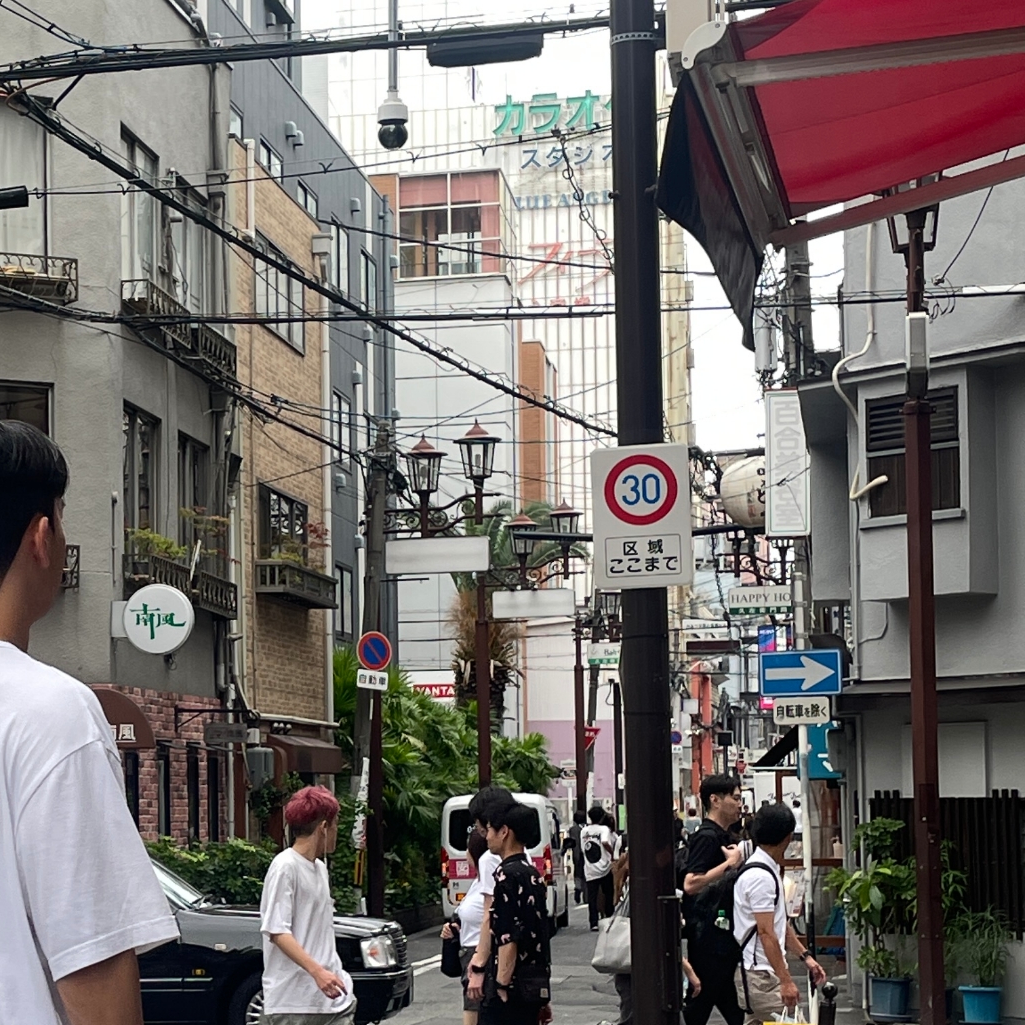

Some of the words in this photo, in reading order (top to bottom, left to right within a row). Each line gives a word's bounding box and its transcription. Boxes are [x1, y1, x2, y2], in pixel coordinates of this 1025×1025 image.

[492, 89, 612, 136] カラオ
[621, 473, 661, 506] 30
[623, 539, 664, 556] 区域
[609, 556, 678, 574] ここまで
[731, 593, 770, 604] HAPPY
[129, 603, 186, 640] 南風
[359, 674, 386, 686] 自動車
[776, 703, 827, 719] 自転車を除く
